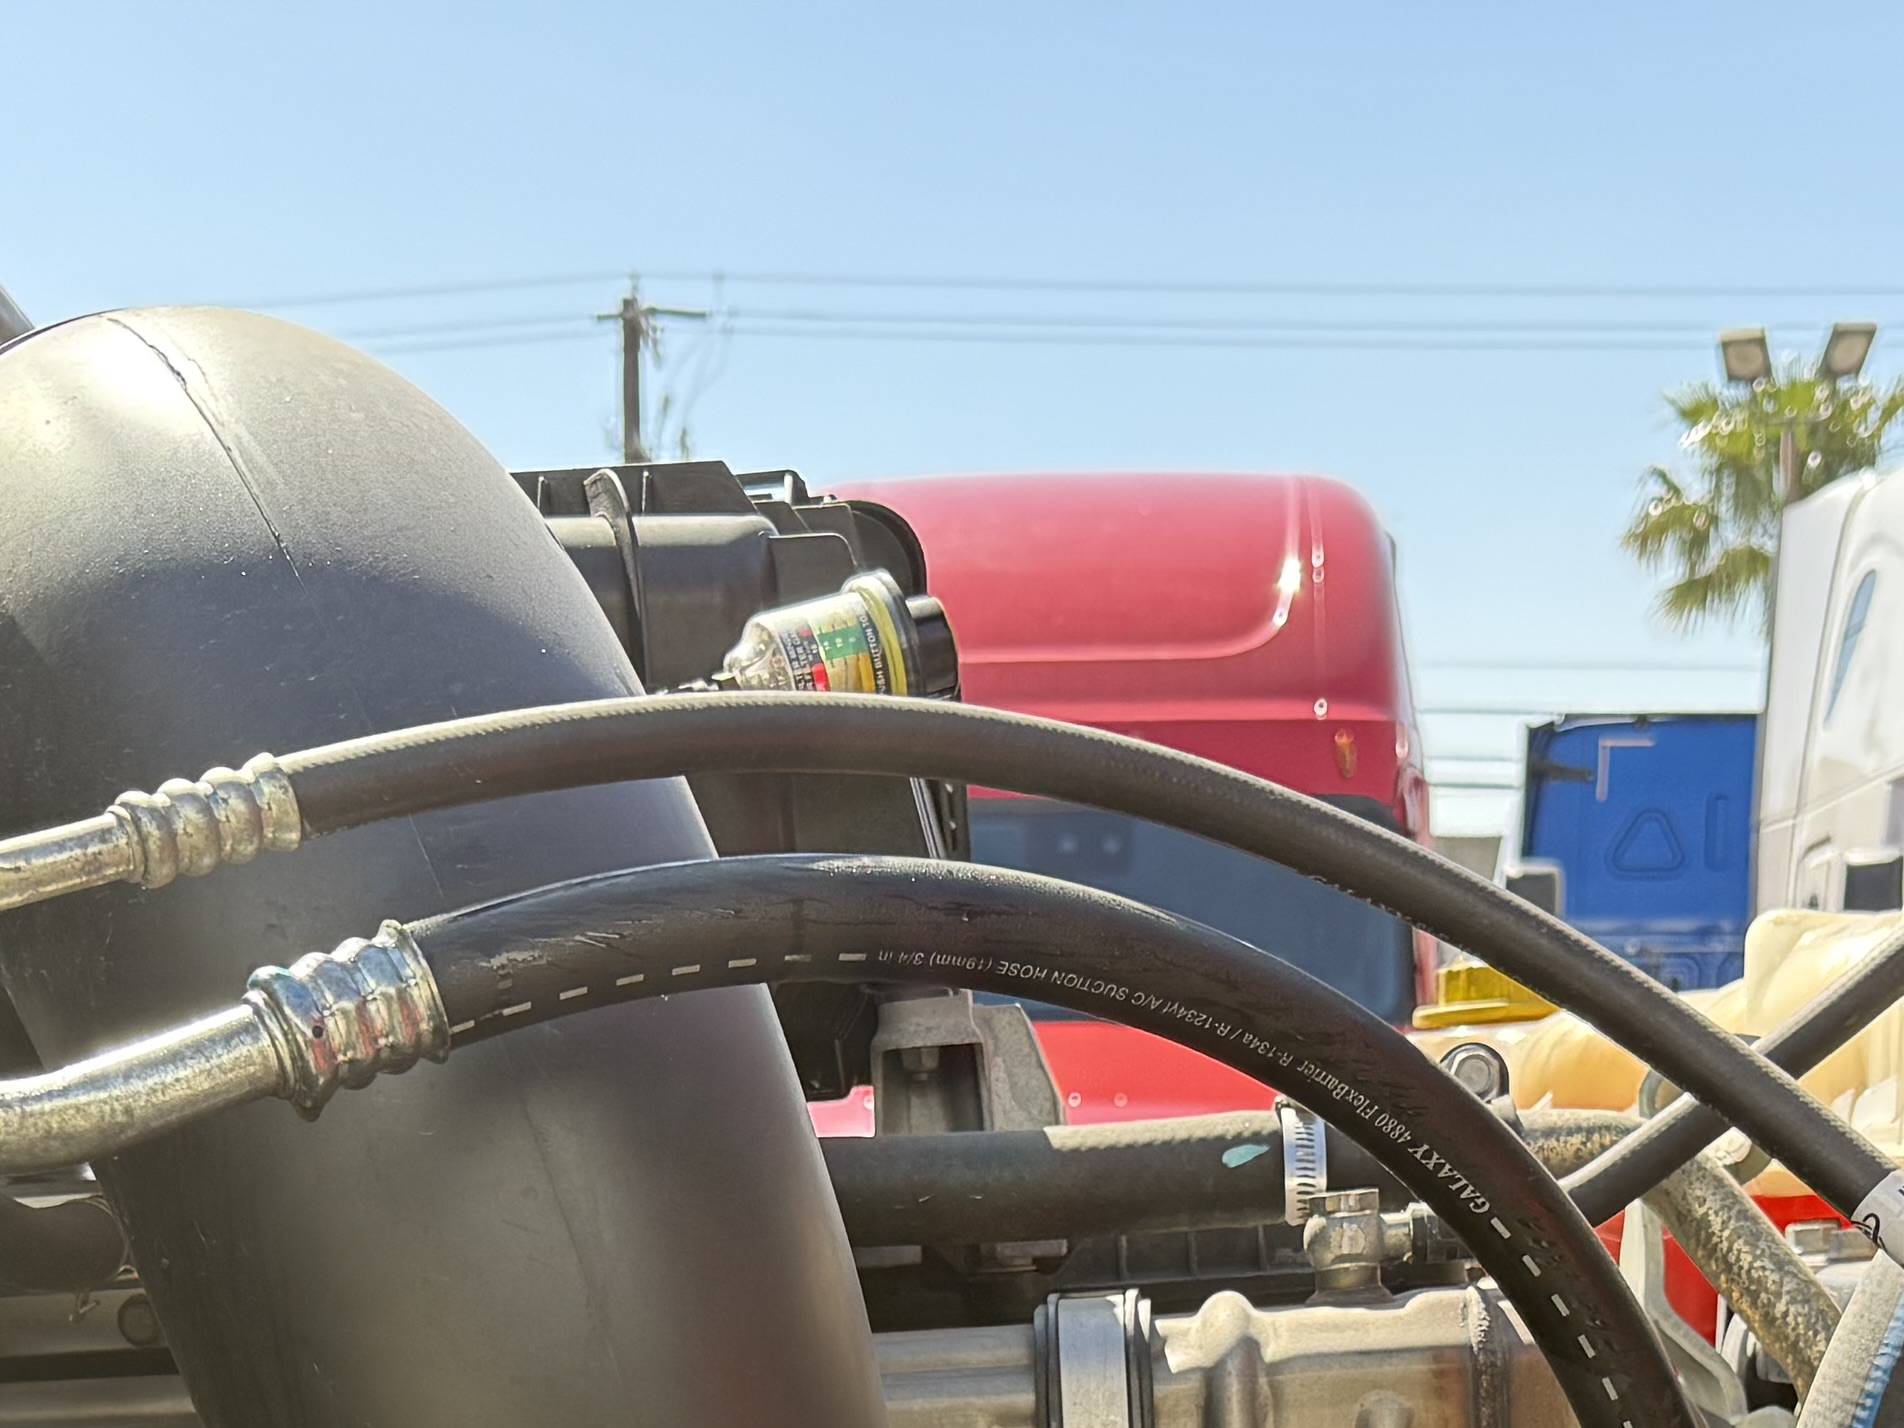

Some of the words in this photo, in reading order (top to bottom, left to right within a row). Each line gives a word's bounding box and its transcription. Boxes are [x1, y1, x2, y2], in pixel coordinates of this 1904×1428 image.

[865, 629, 883, 669] BUTTON
[878, 950, 894, 962] in
[899, 951, 925, 966] 3/4
[929, 950, 993, 971] (19mm)
[997, 960, 1048, 980] HOSE
[1049, 970, 1129, 1001] SUCTION
[1131, 991, 1163, 1011] A/C
[1160, 1005, 1232, 1037] R-1234yf
[1242, 1031, 1294, 1067] R-134a
[1297, 1060, 1379, 1121] FlexBarrier
[1374, 1112, 1412, 1144] 4880
[1407, 1144, 1490, 1213] GALAXY
